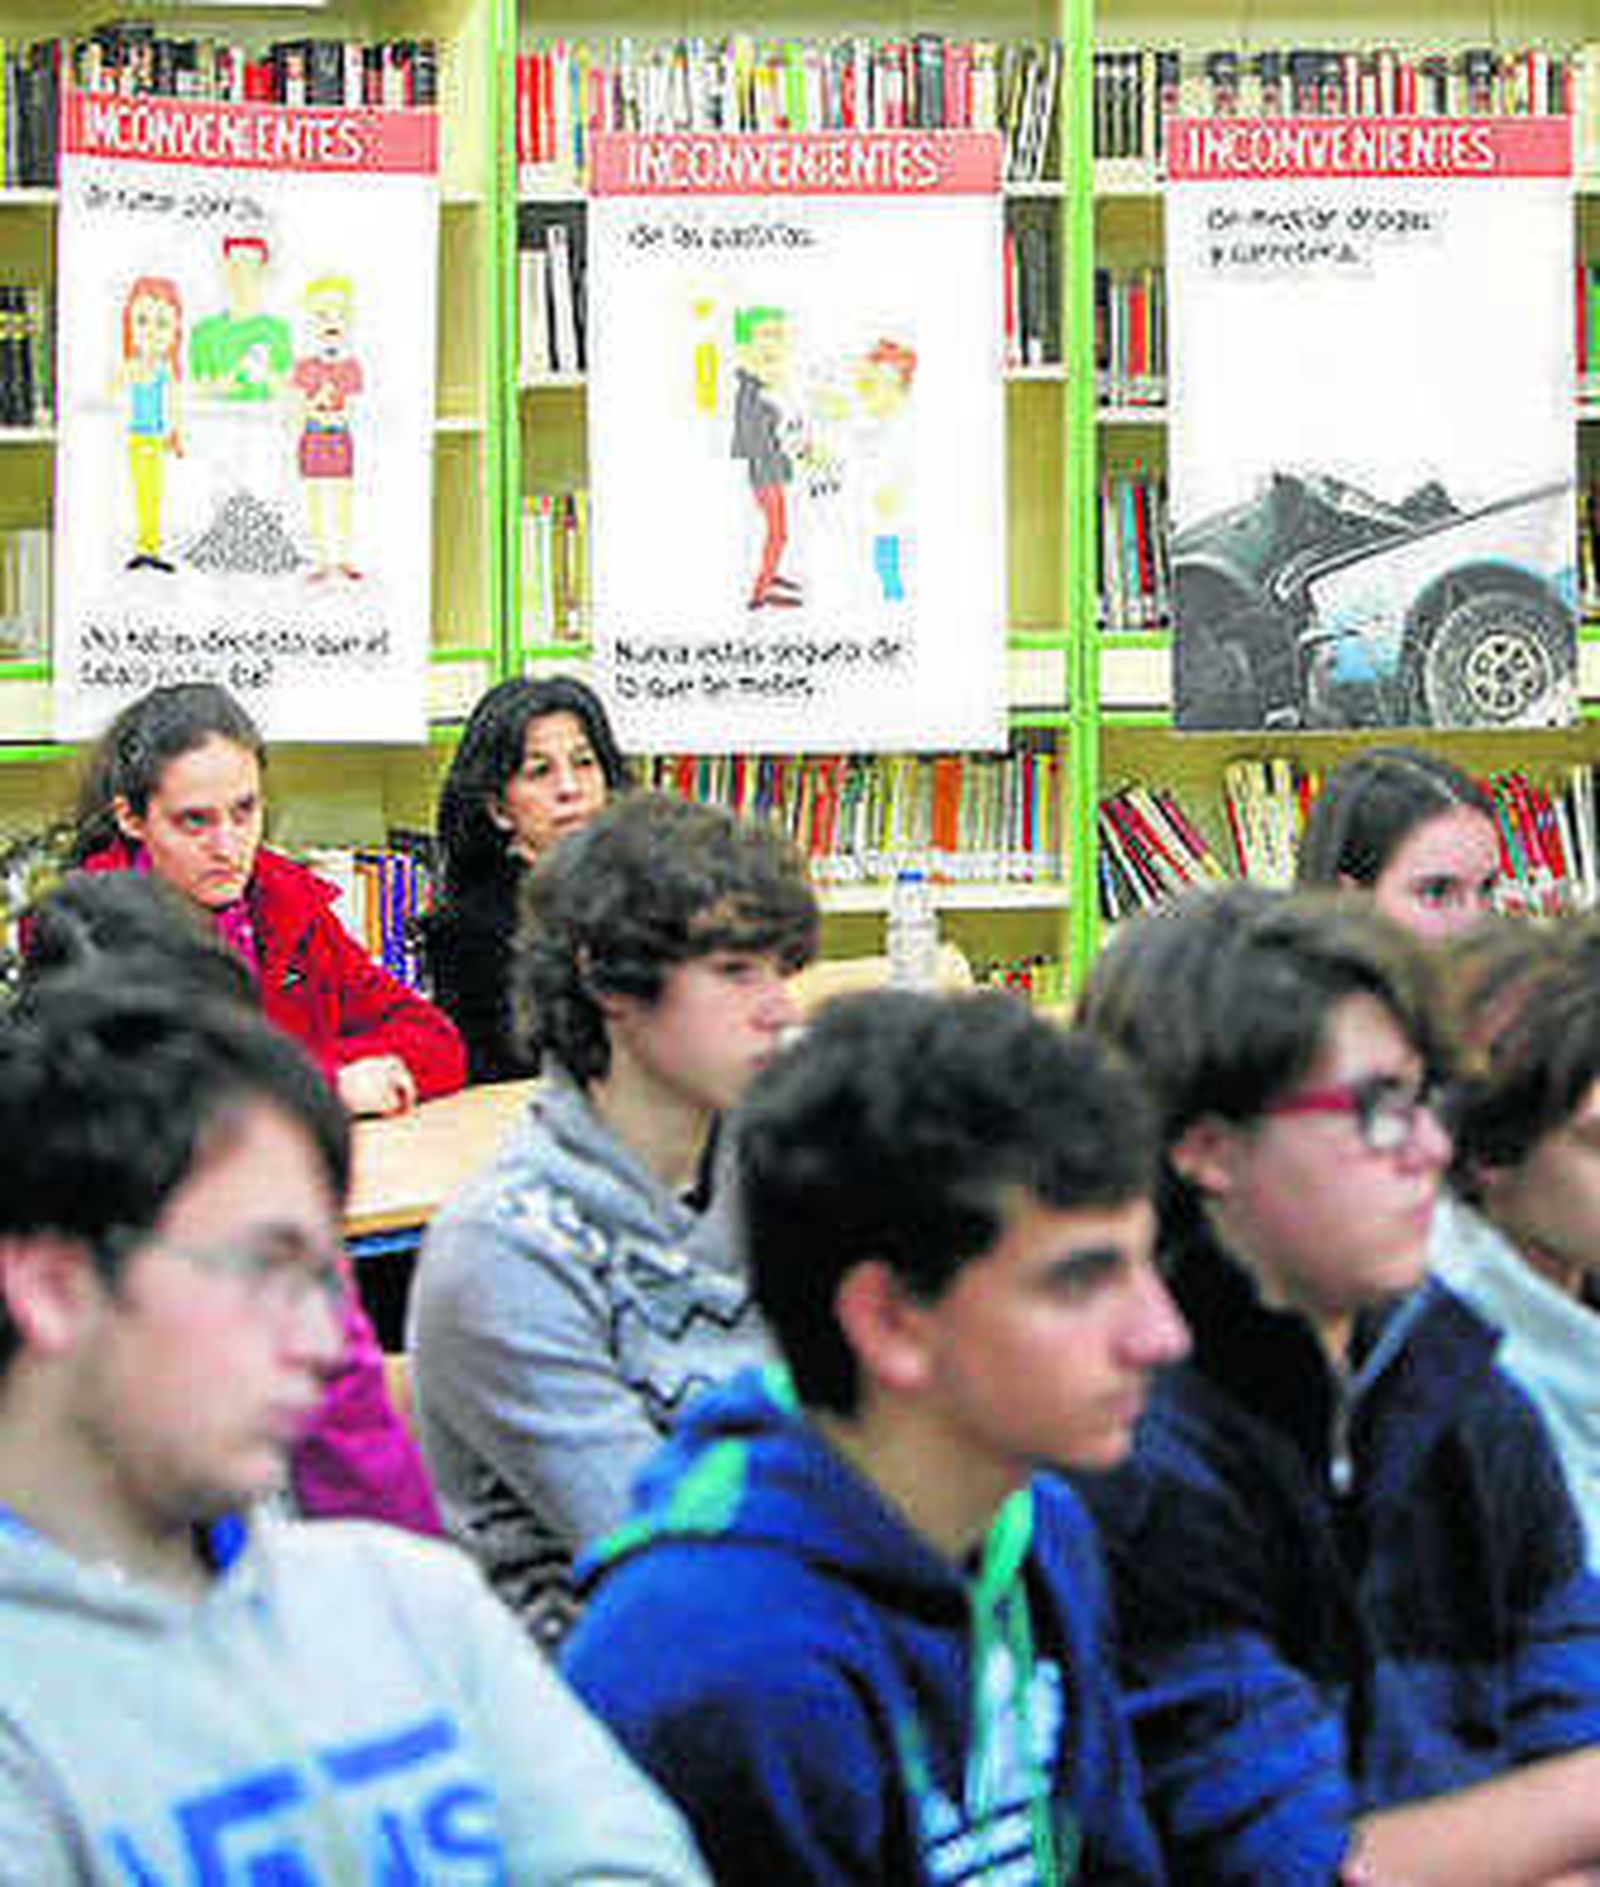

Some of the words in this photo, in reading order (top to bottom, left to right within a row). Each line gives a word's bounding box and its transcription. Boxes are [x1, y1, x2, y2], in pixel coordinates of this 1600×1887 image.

[86, 102, 367, 162] INCONVENIENTES
[1188, 125, 1496, 170] INCONVENIENTES
[628, 139, 940, 187] INCONVENIENTES
